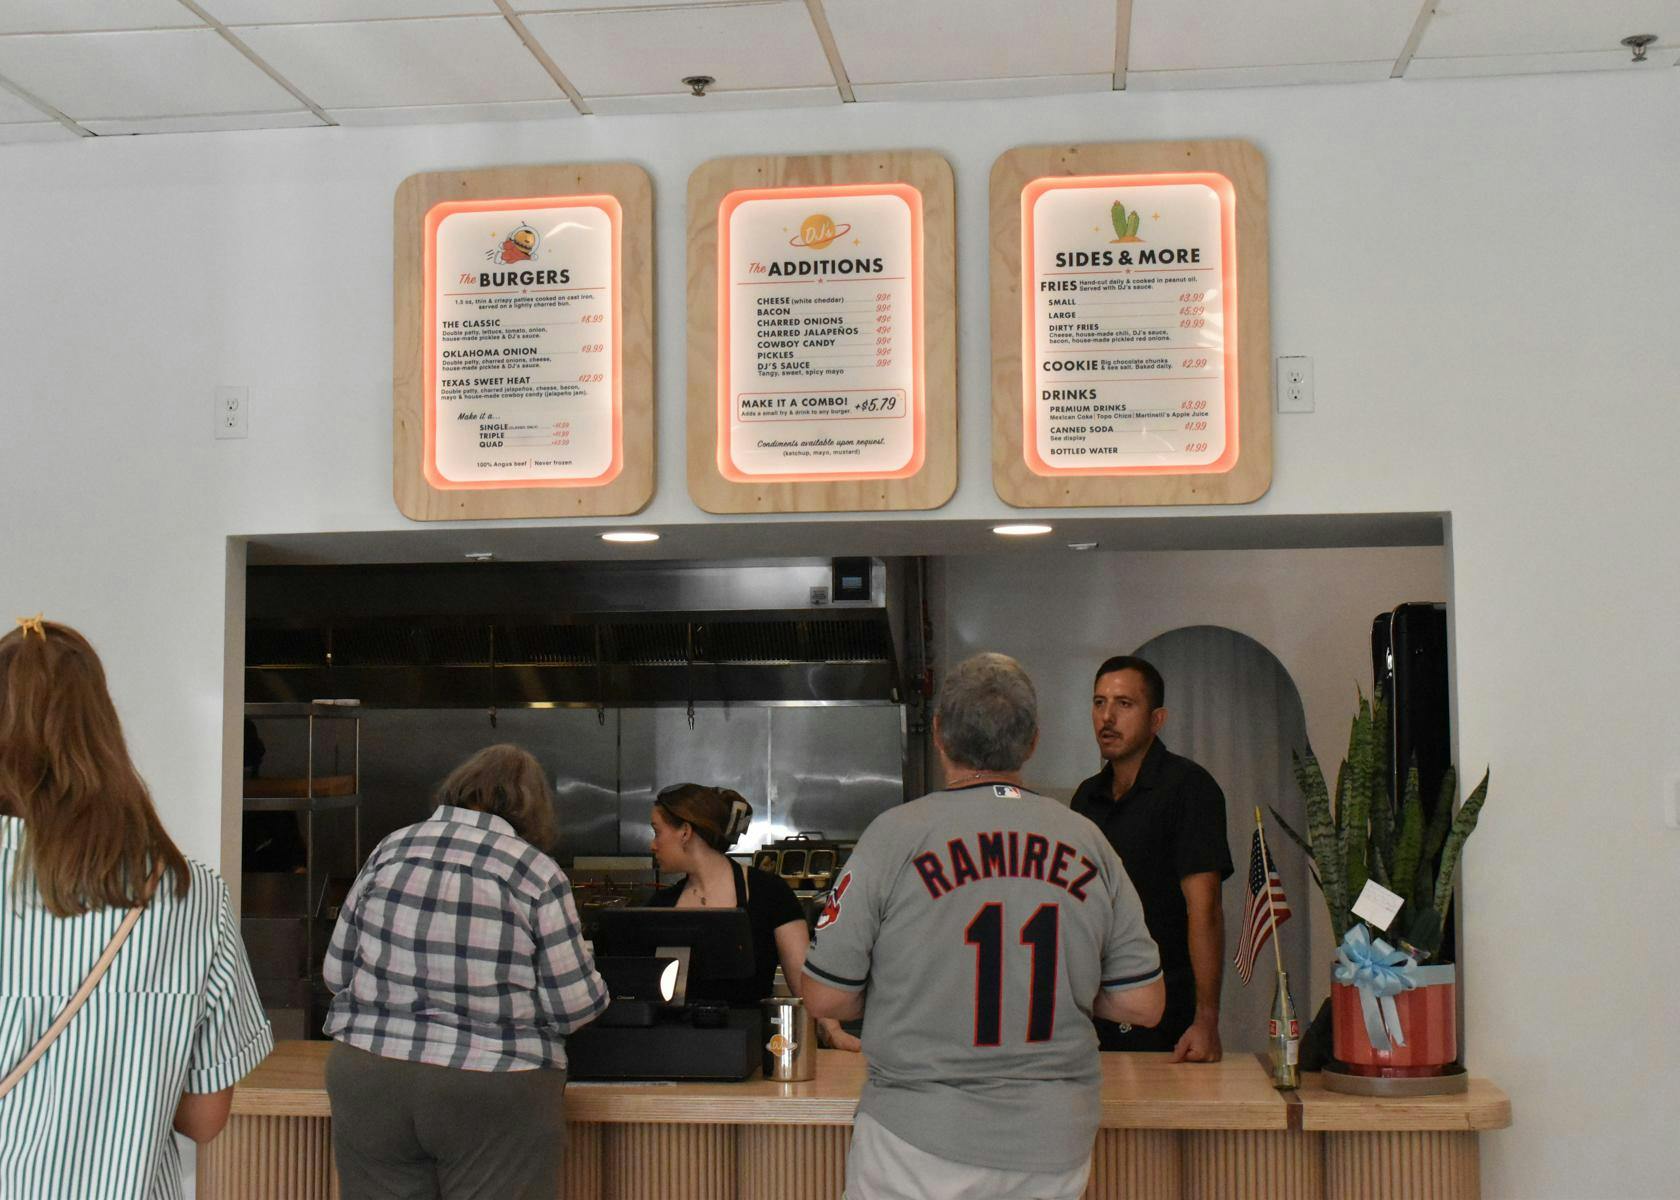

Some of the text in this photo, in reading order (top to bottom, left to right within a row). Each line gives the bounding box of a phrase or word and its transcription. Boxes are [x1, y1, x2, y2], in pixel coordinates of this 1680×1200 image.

[1056, 248, 1200, 268] SIDES & MORE
[748, 258, 884, 276] The ADDITIONS
[458, 269, 570, 287] The BURGERS
[1040, 280, 1078, 292] FRIES
[757, 297, 790, 305] CHEESE
[462, 319, 500, 328] CLASSIC
[757, 318, 800, 326] CHARRED
[804, 317, 844, 325] ONIONS
[758, 330, 800, 338] CHARRED
[804, 326, 858, 336] JALAPEÑOS
[758, 340, 800, 348] COWBOY
[442, 349, 500, 358] OKLAHOMA
[503, 348, 538, 356] ONION
[1042, 360, 1098, 372] COOKIE
[442, 378, 470, 386] TEXAS
[507, 376, 530, 384] HEAT
[1042, 389, 1097, 400] DRINKS
[742, 396, 896, 412] MAKE IT A COMBO! +$5.79
[757, 440, 798, 448] Condiments
[800, 438, 834, 446] available
[912, 830, 1099, 901] RAMIREZ
[963, 901, 1059, 1047] 11
